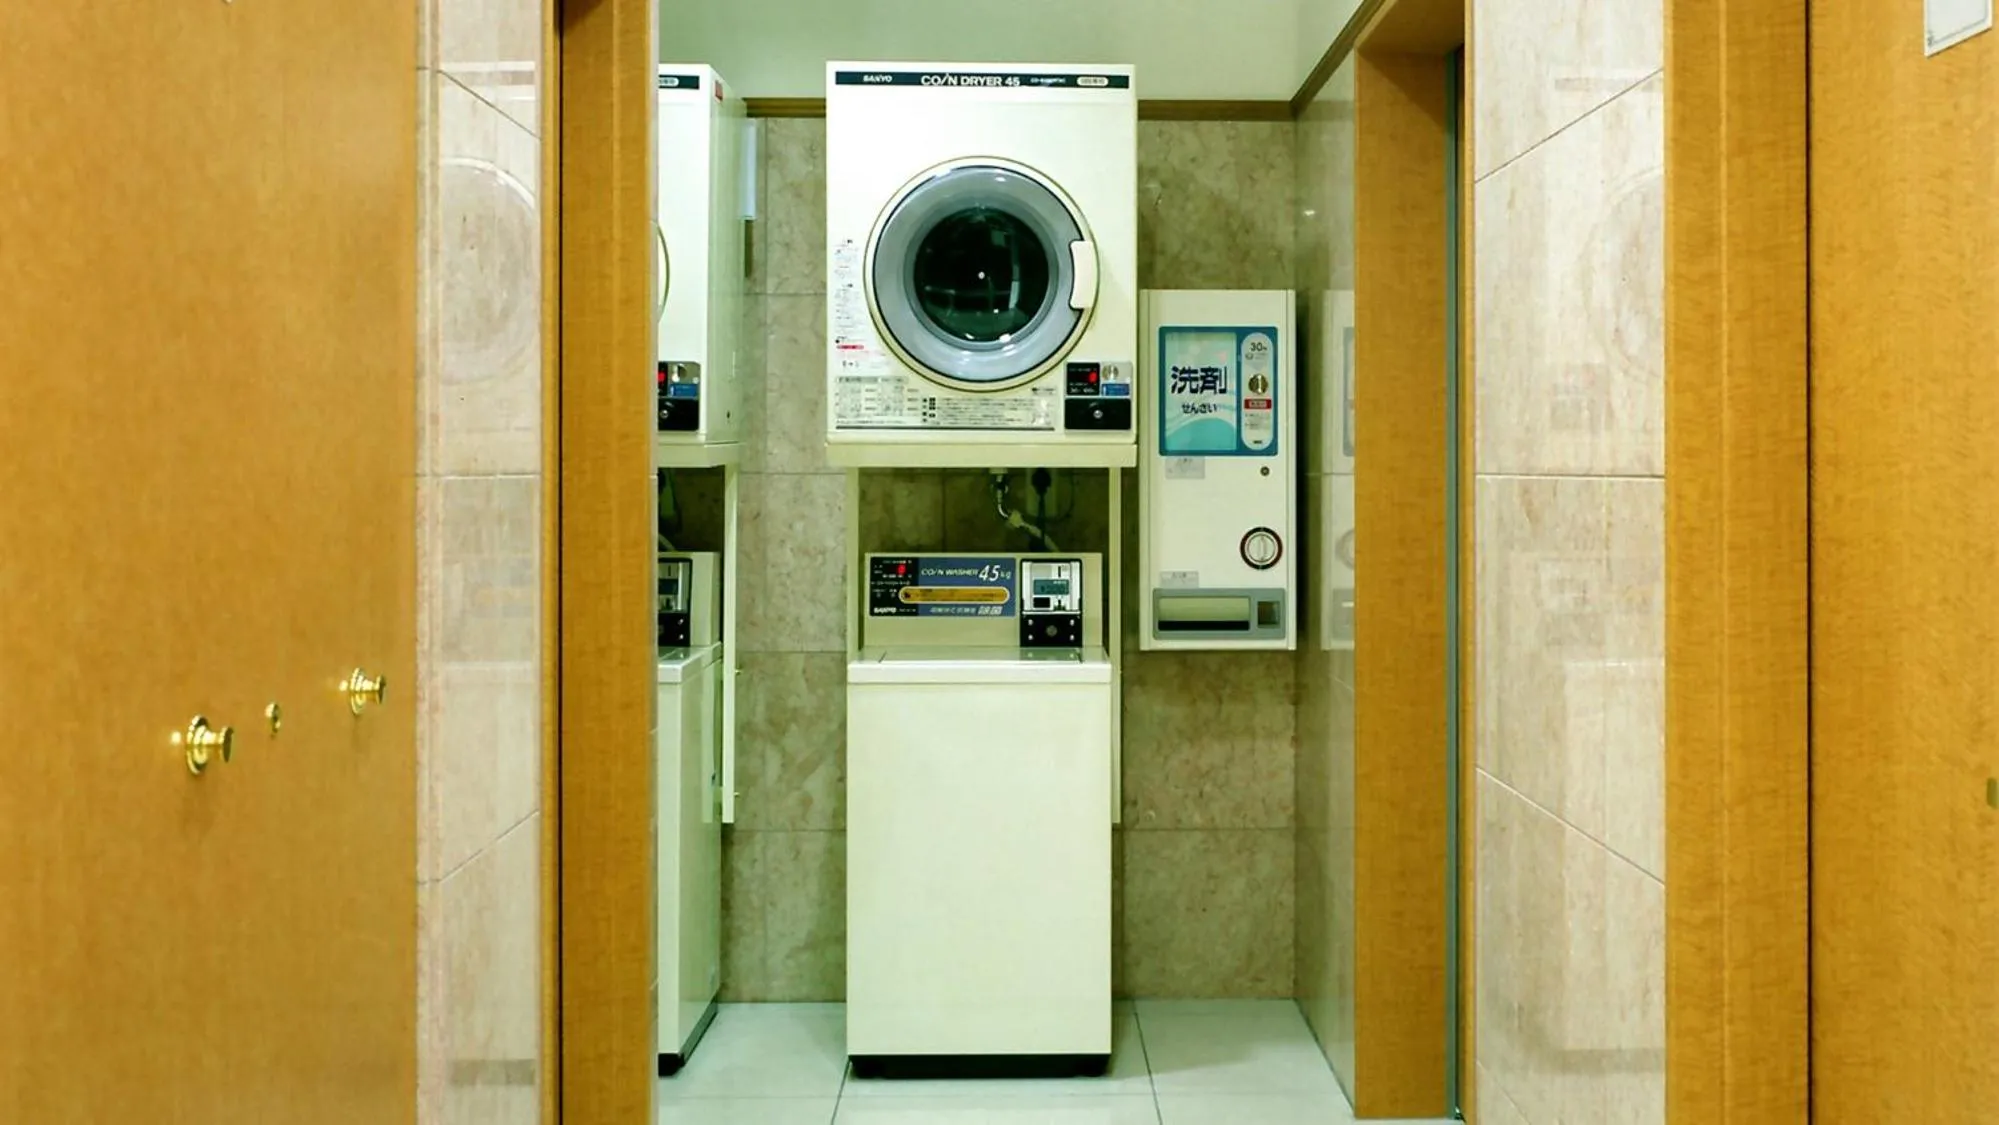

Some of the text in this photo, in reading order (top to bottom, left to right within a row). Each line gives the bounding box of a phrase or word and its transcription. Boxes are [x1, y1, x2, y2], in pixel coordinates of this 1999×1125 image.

[960, 75, 1003, 86] DRYER
[1004, 76, 1020, 87] 45
[1171, 365, 1228, 395] 洗剤
[945, 568, 978, 576] WASHER
[978, 564, 1001, 582] 45
[873, 606, 897, 614] SANYO
